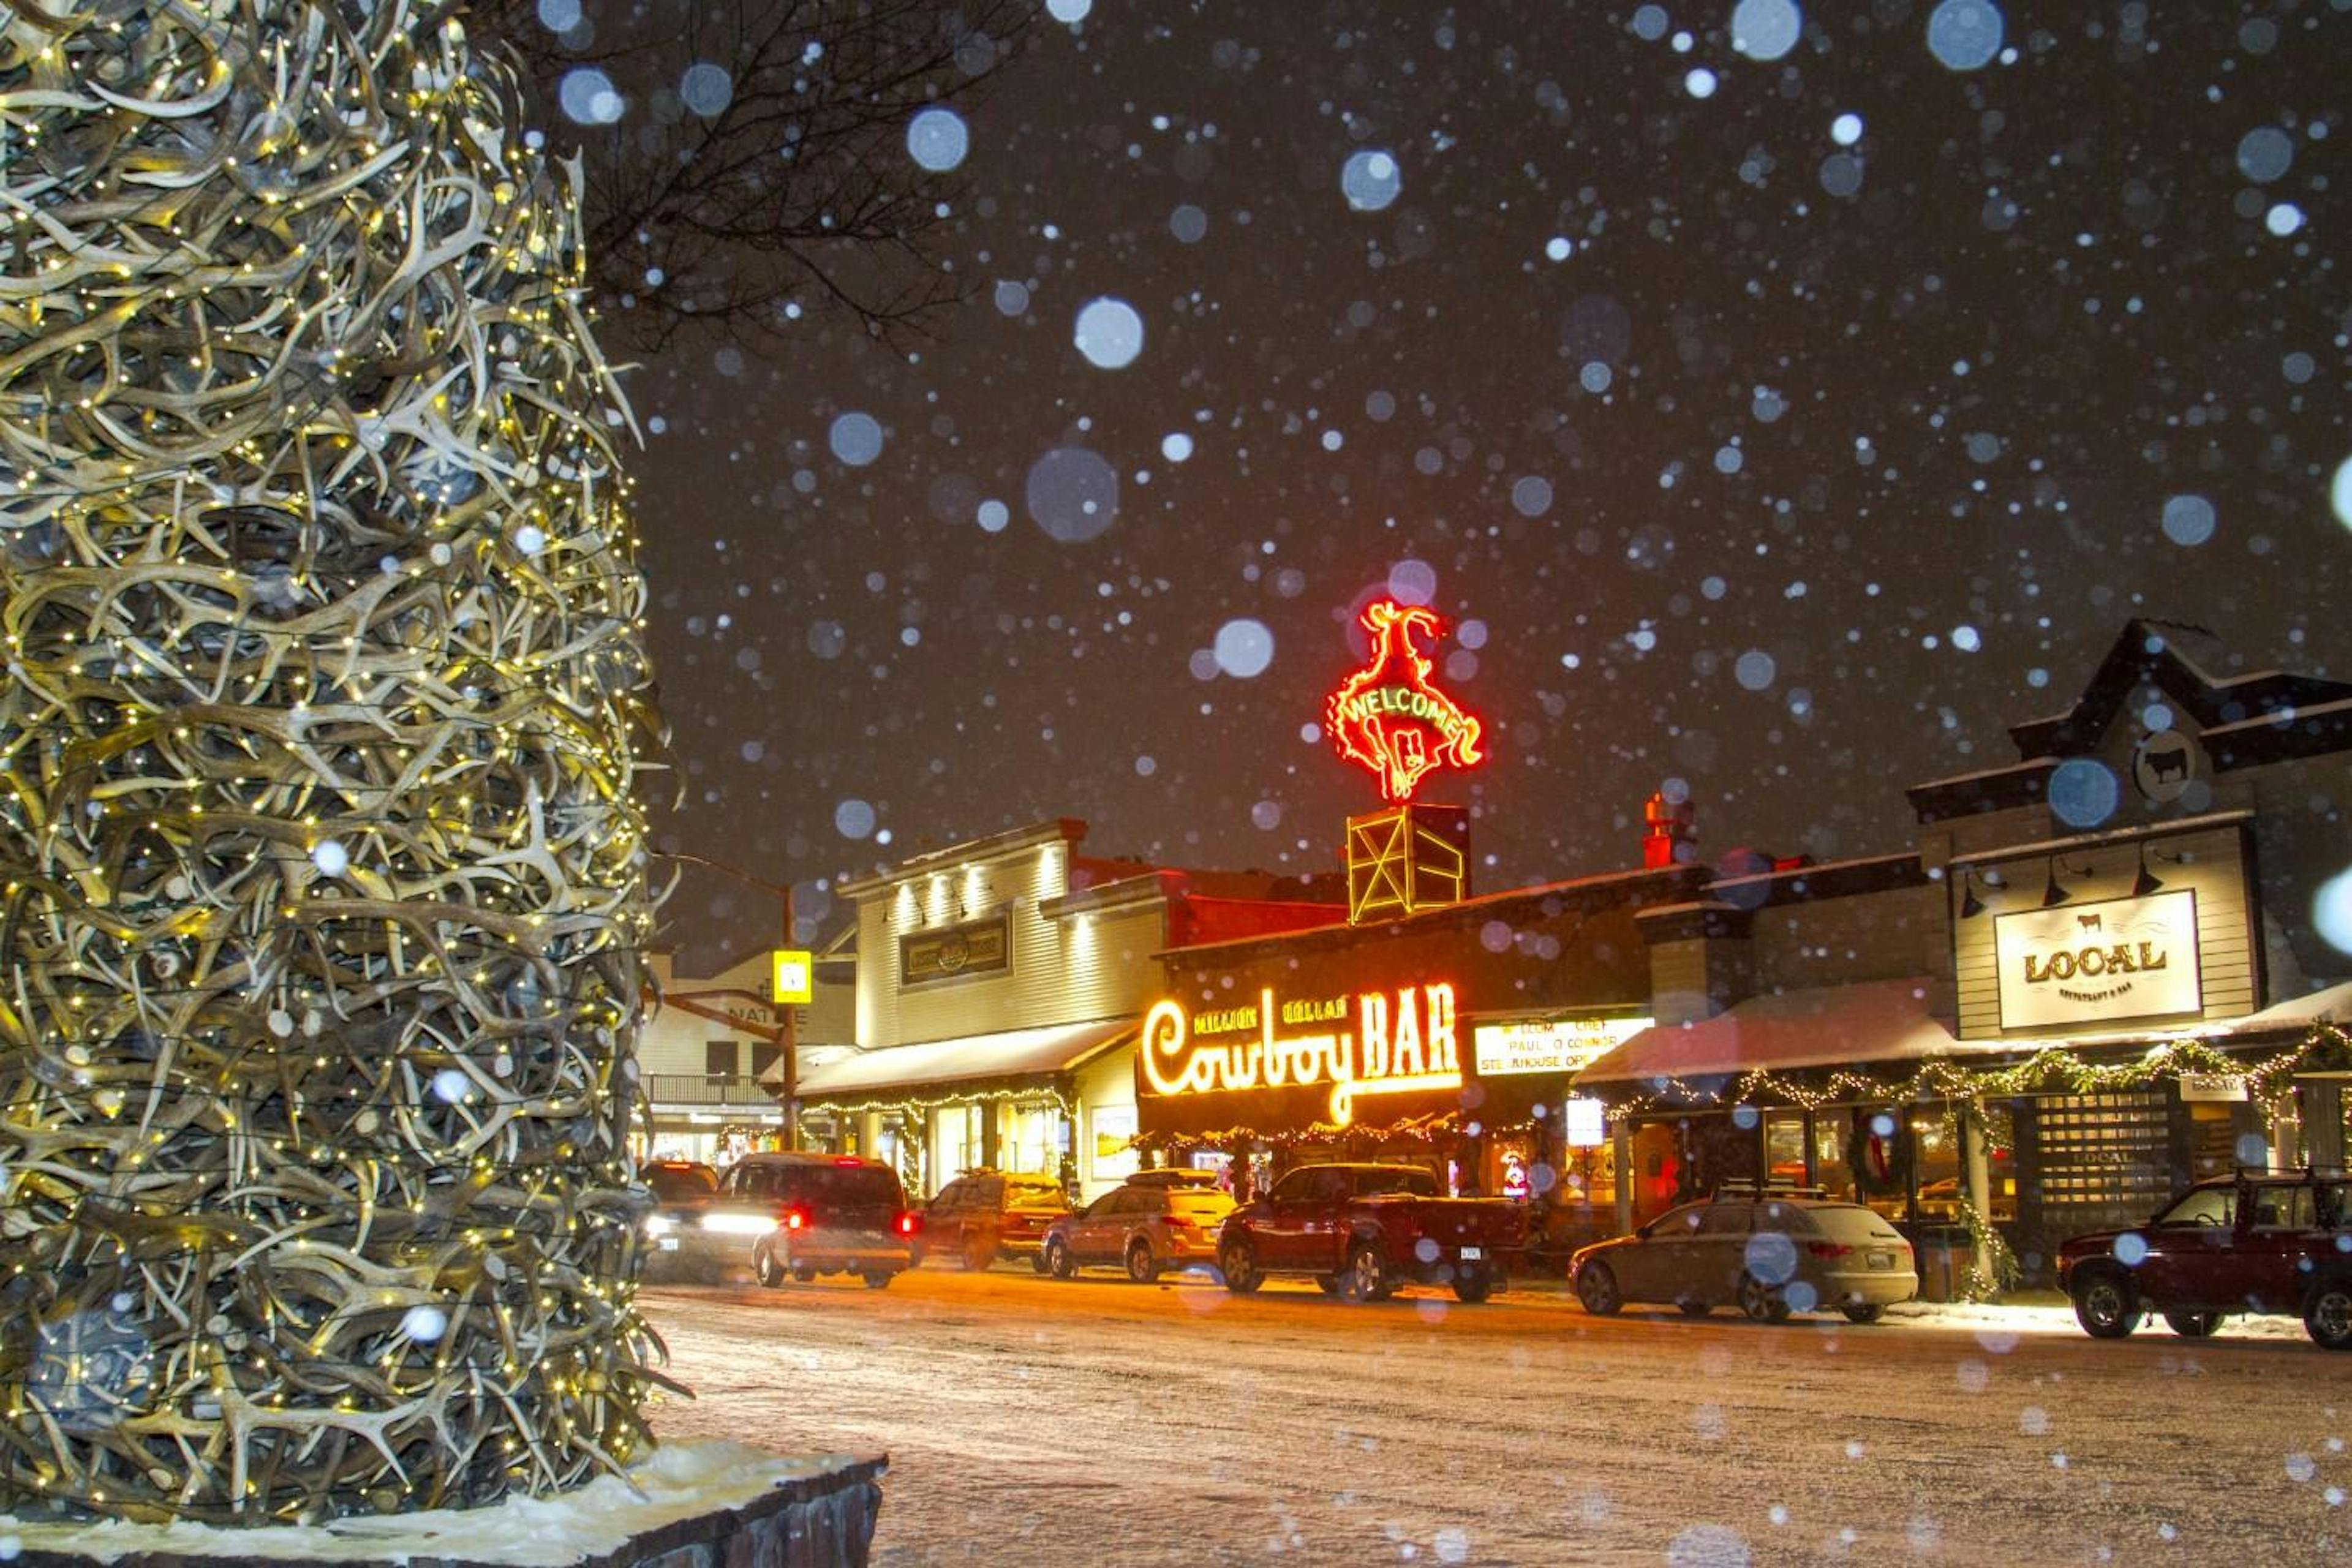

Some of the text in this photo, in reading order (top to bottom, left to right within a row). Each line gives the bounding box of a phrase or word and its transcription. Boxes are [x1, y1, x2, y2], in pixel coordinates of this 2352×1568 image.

[1342, 687, 1461, 739] WELCOME
[2023, 941, 2166, 983] LOCAL
[1194, 996, 1348, 1035] MILLION DOLLAR
[1142, 983, 1460, 1126] Cowboy BAR
[1509, 1039, 1544, 1052] PAUL
[2075, 1152, 2132, 1164] LOCAL
